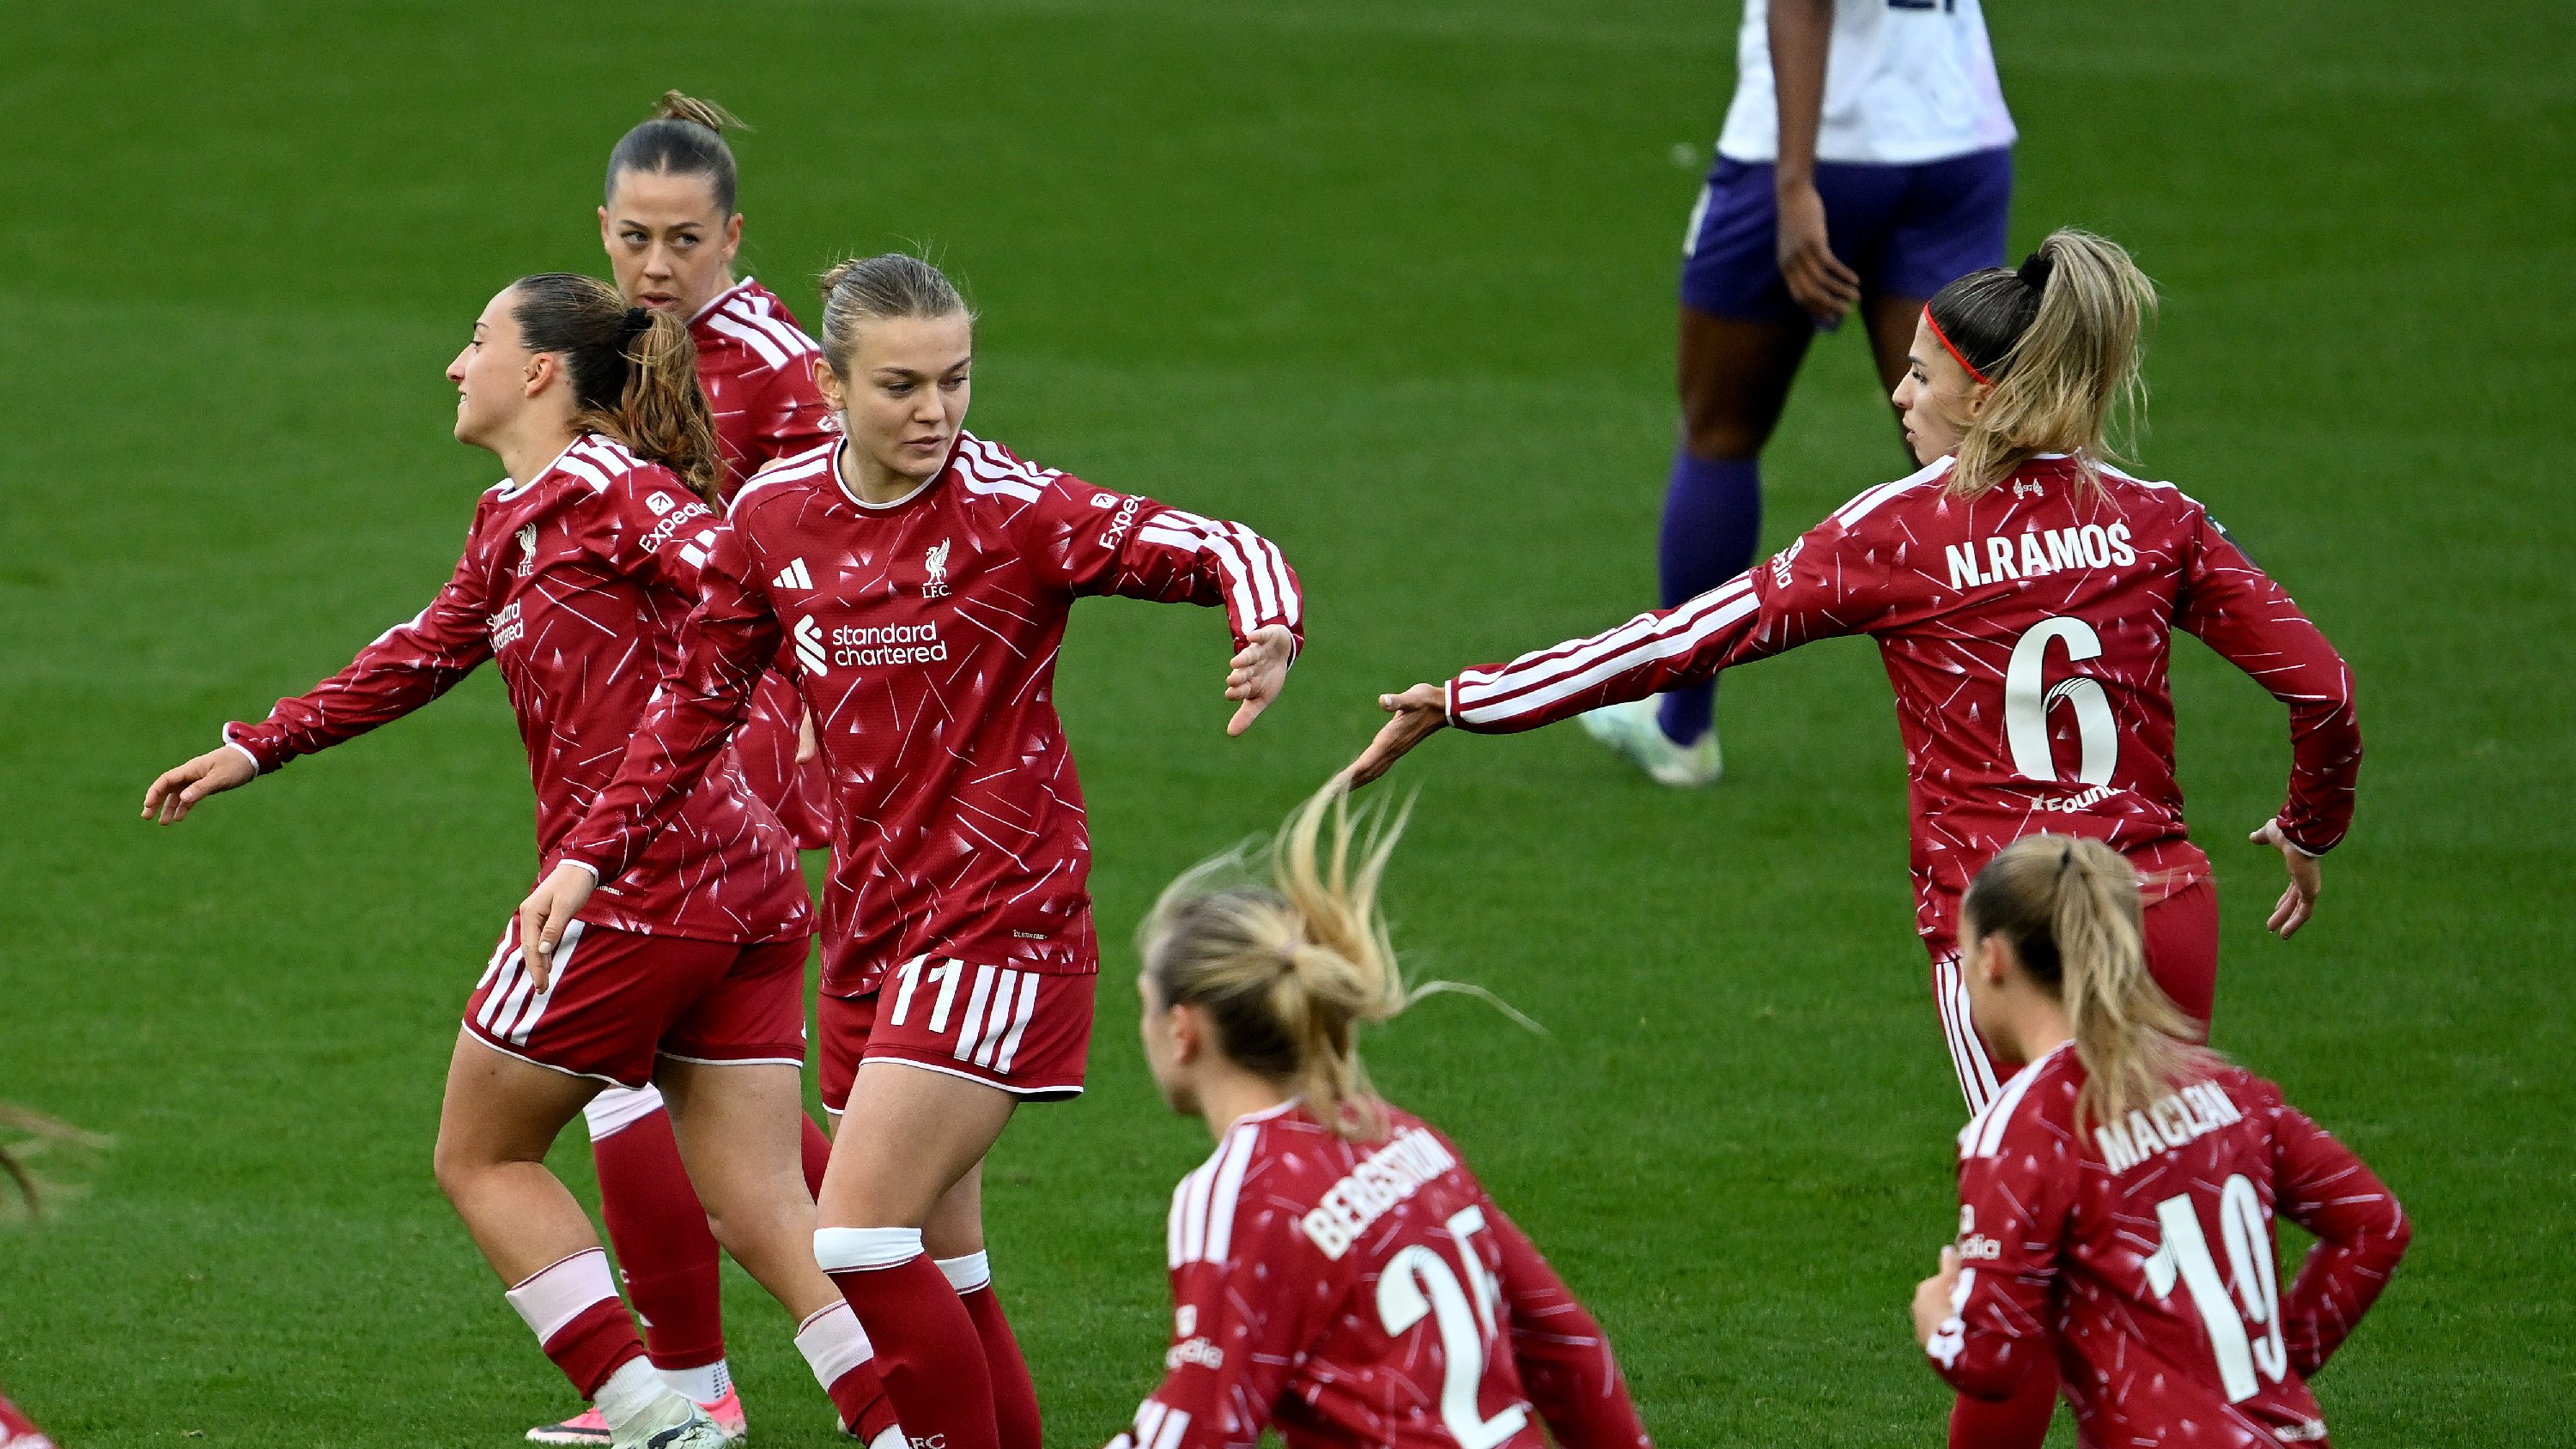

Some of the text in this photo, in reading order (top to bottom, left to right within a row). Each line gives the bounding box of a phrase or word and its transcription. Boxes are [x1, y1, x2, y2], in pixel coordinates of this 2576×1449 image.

[1945, 523, 2136, 590] N.RAMOS
[832, 619, 937, 646] standard
[835, 640, 948, 666] chartered
[2004, 615, 2118, 785] 6
[890, 952, 965, 1034] 11
[2143, 1173, 2287, 1405] 19
[908, 1433, 946, 1449] FC
